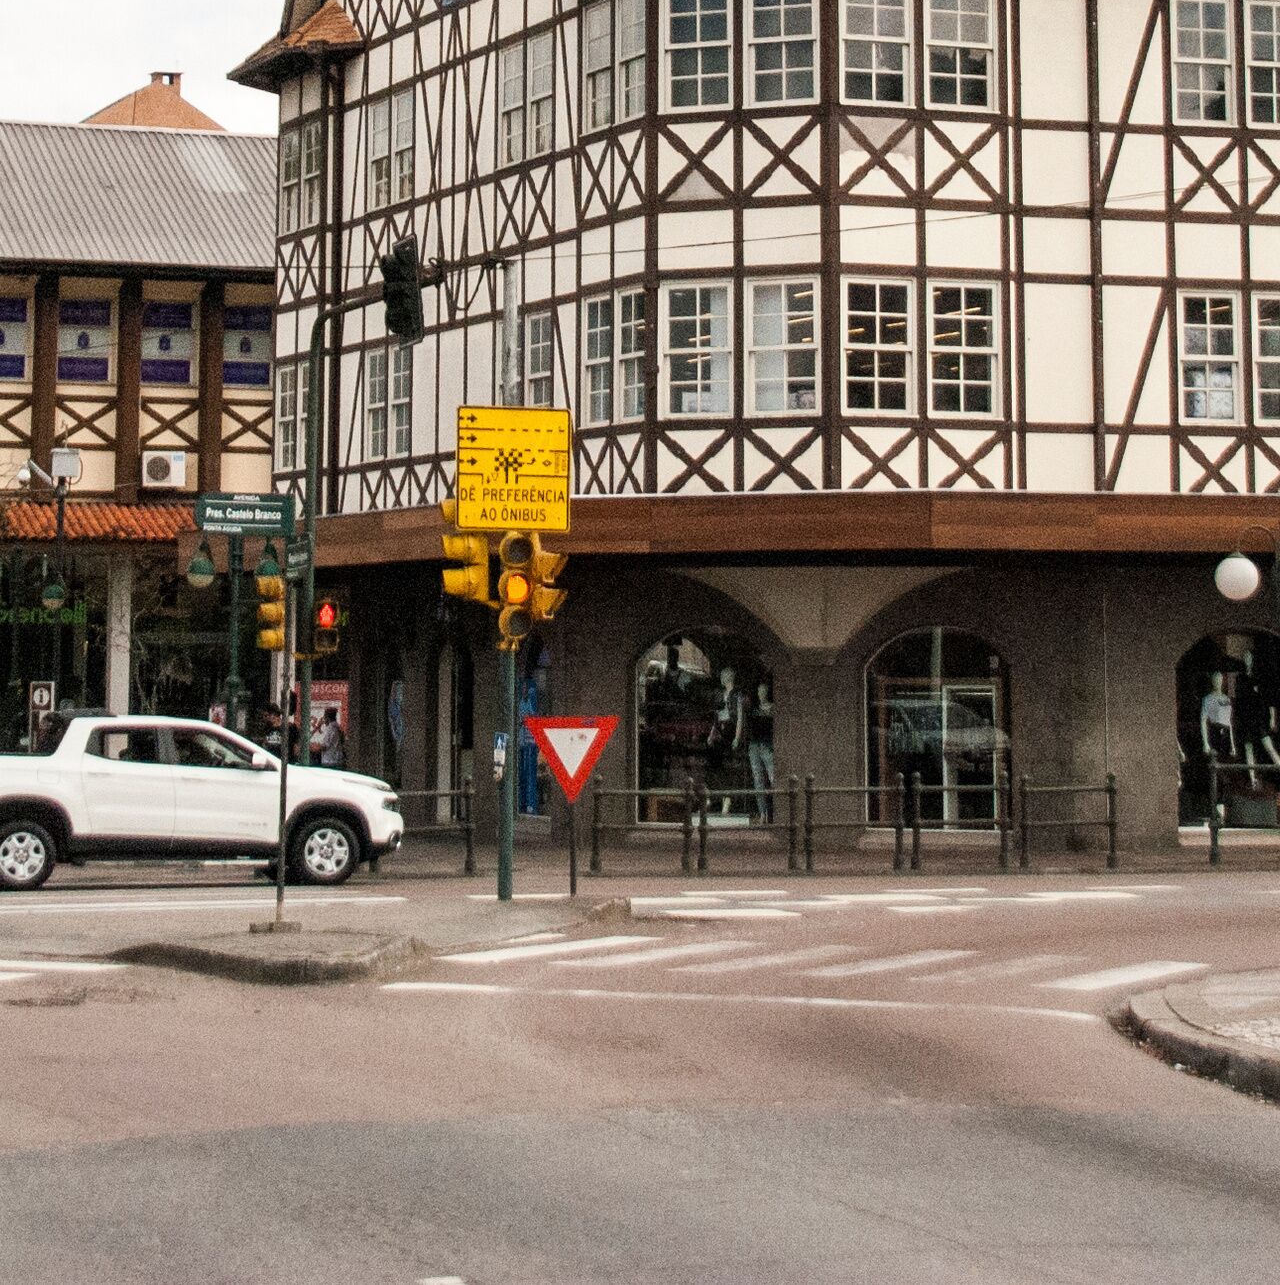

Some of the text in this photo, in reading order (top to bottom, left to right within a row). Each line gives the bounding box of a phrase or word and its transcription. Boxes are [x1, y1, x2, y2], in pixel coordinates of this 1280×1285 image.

[460, 484, 565, 503] DÊ PREFERÊNCIA
[206, 507, 282, 520] Pres. Castelo Branco
[480, 504, 547, 522] AO ÔNIBUS
